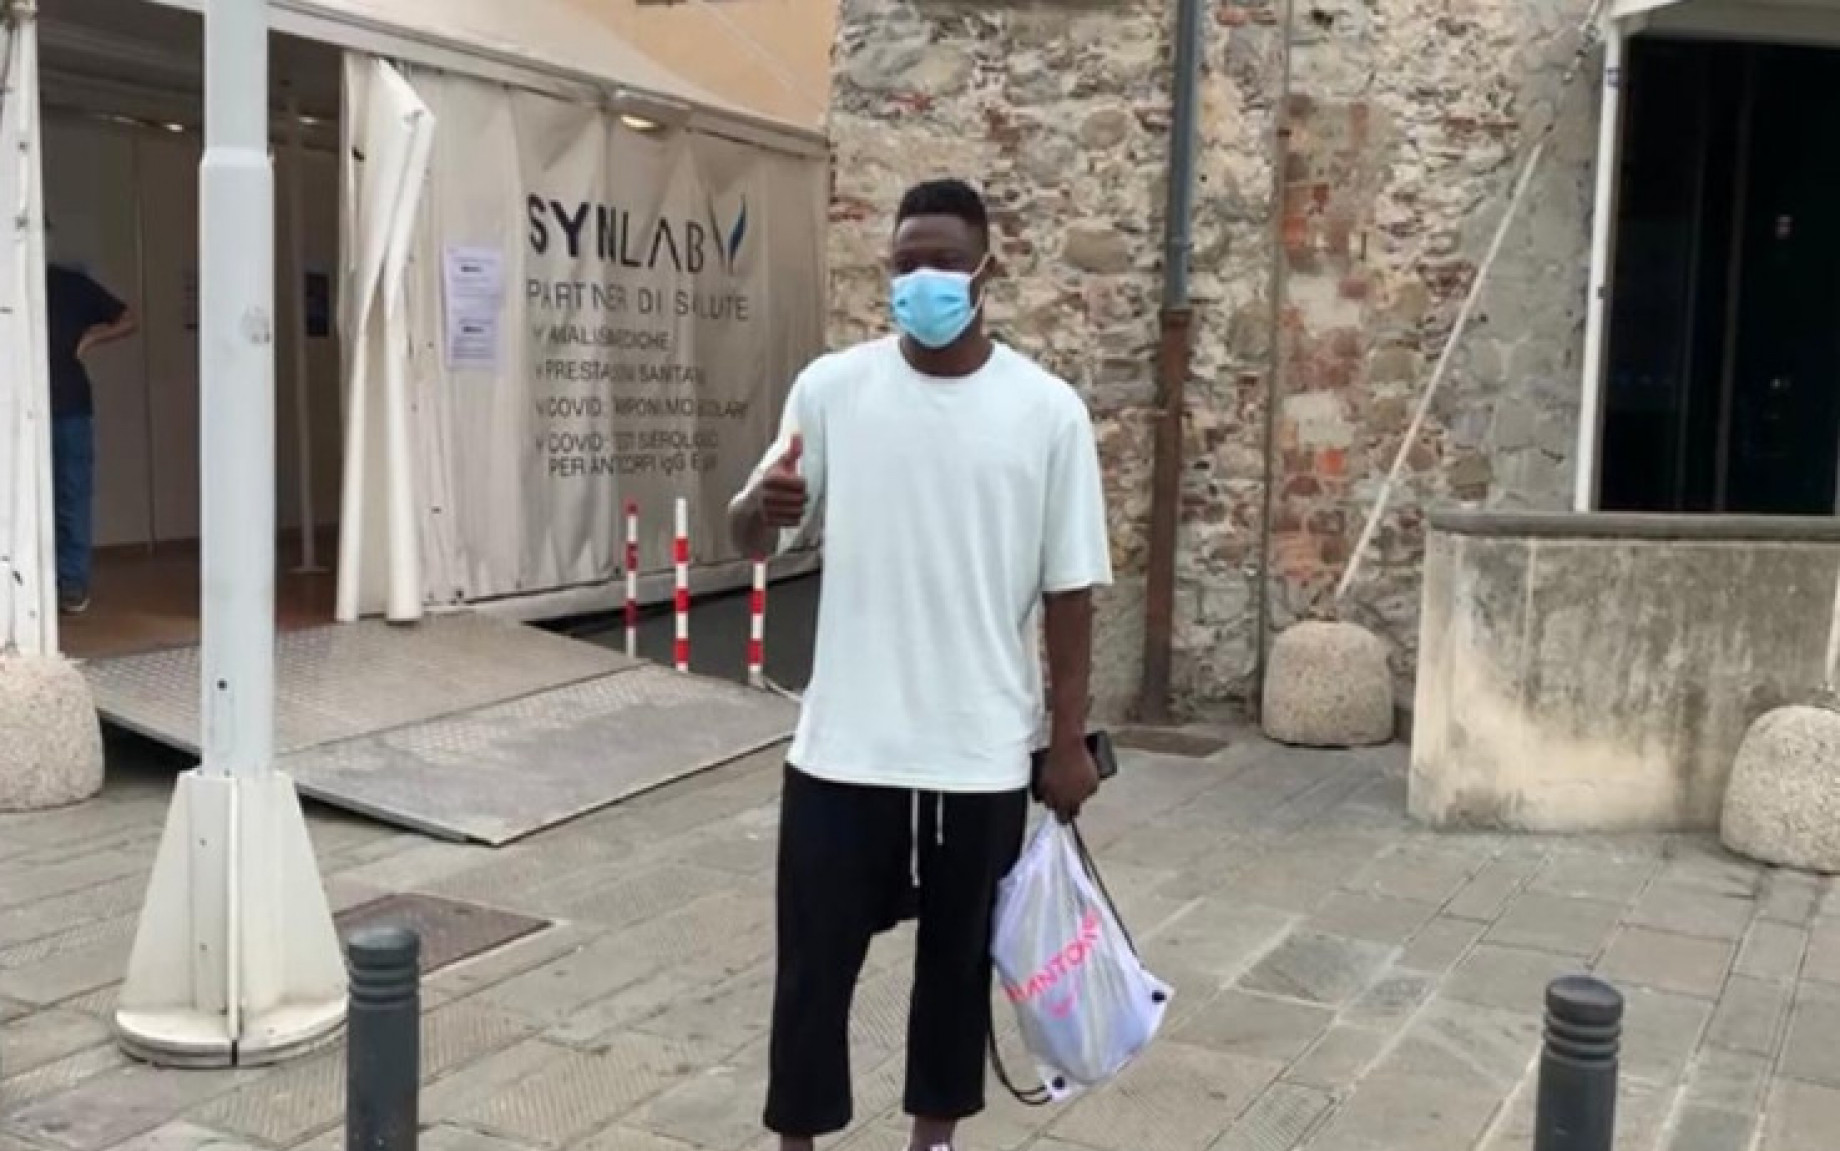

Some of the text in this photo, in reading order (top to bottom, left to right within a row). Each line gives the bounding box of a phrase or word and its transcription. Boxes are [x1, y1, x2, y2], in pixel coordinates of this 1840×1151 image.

[526, 193, 705, 273] SYNLAB
[637, 287, 662, 314] DI
[546, 359, 634, 382] PRESTA
